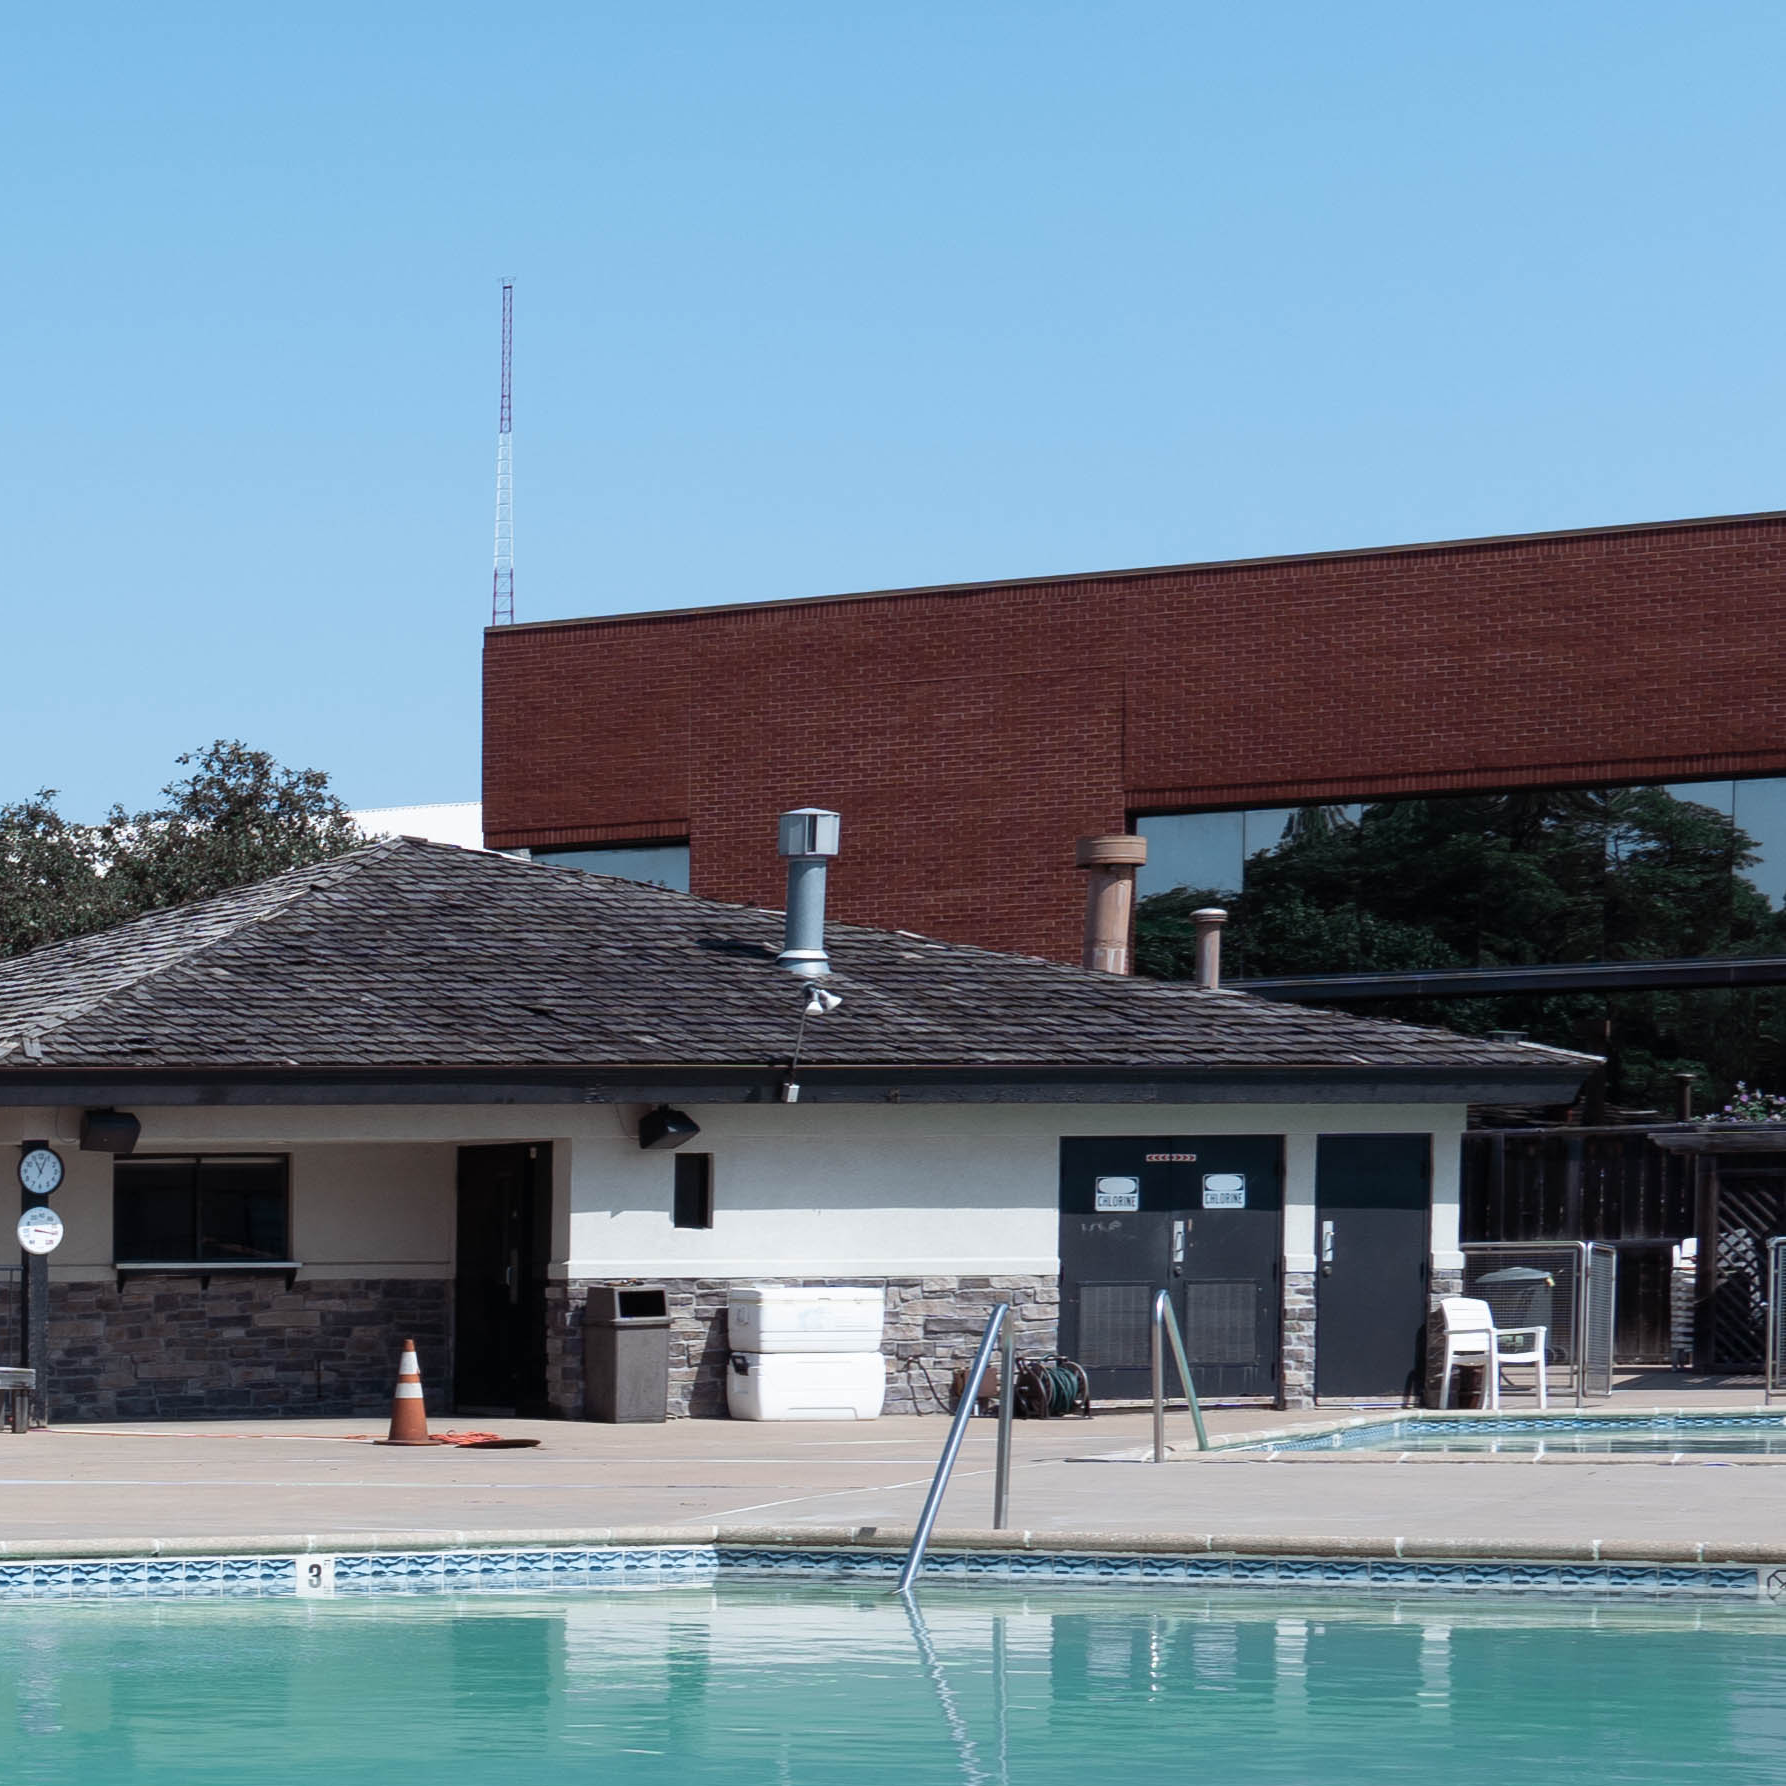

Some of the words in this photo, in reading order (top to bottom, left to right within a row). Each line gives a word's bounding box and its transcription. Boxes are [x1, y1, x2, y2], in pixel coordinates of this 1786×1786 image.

[1097, 1195, 1136, 1208] CHLORINE
[1204, 1192, 1243, 1204] CHLORINE
[308, 1563, 322, 1583] 3
